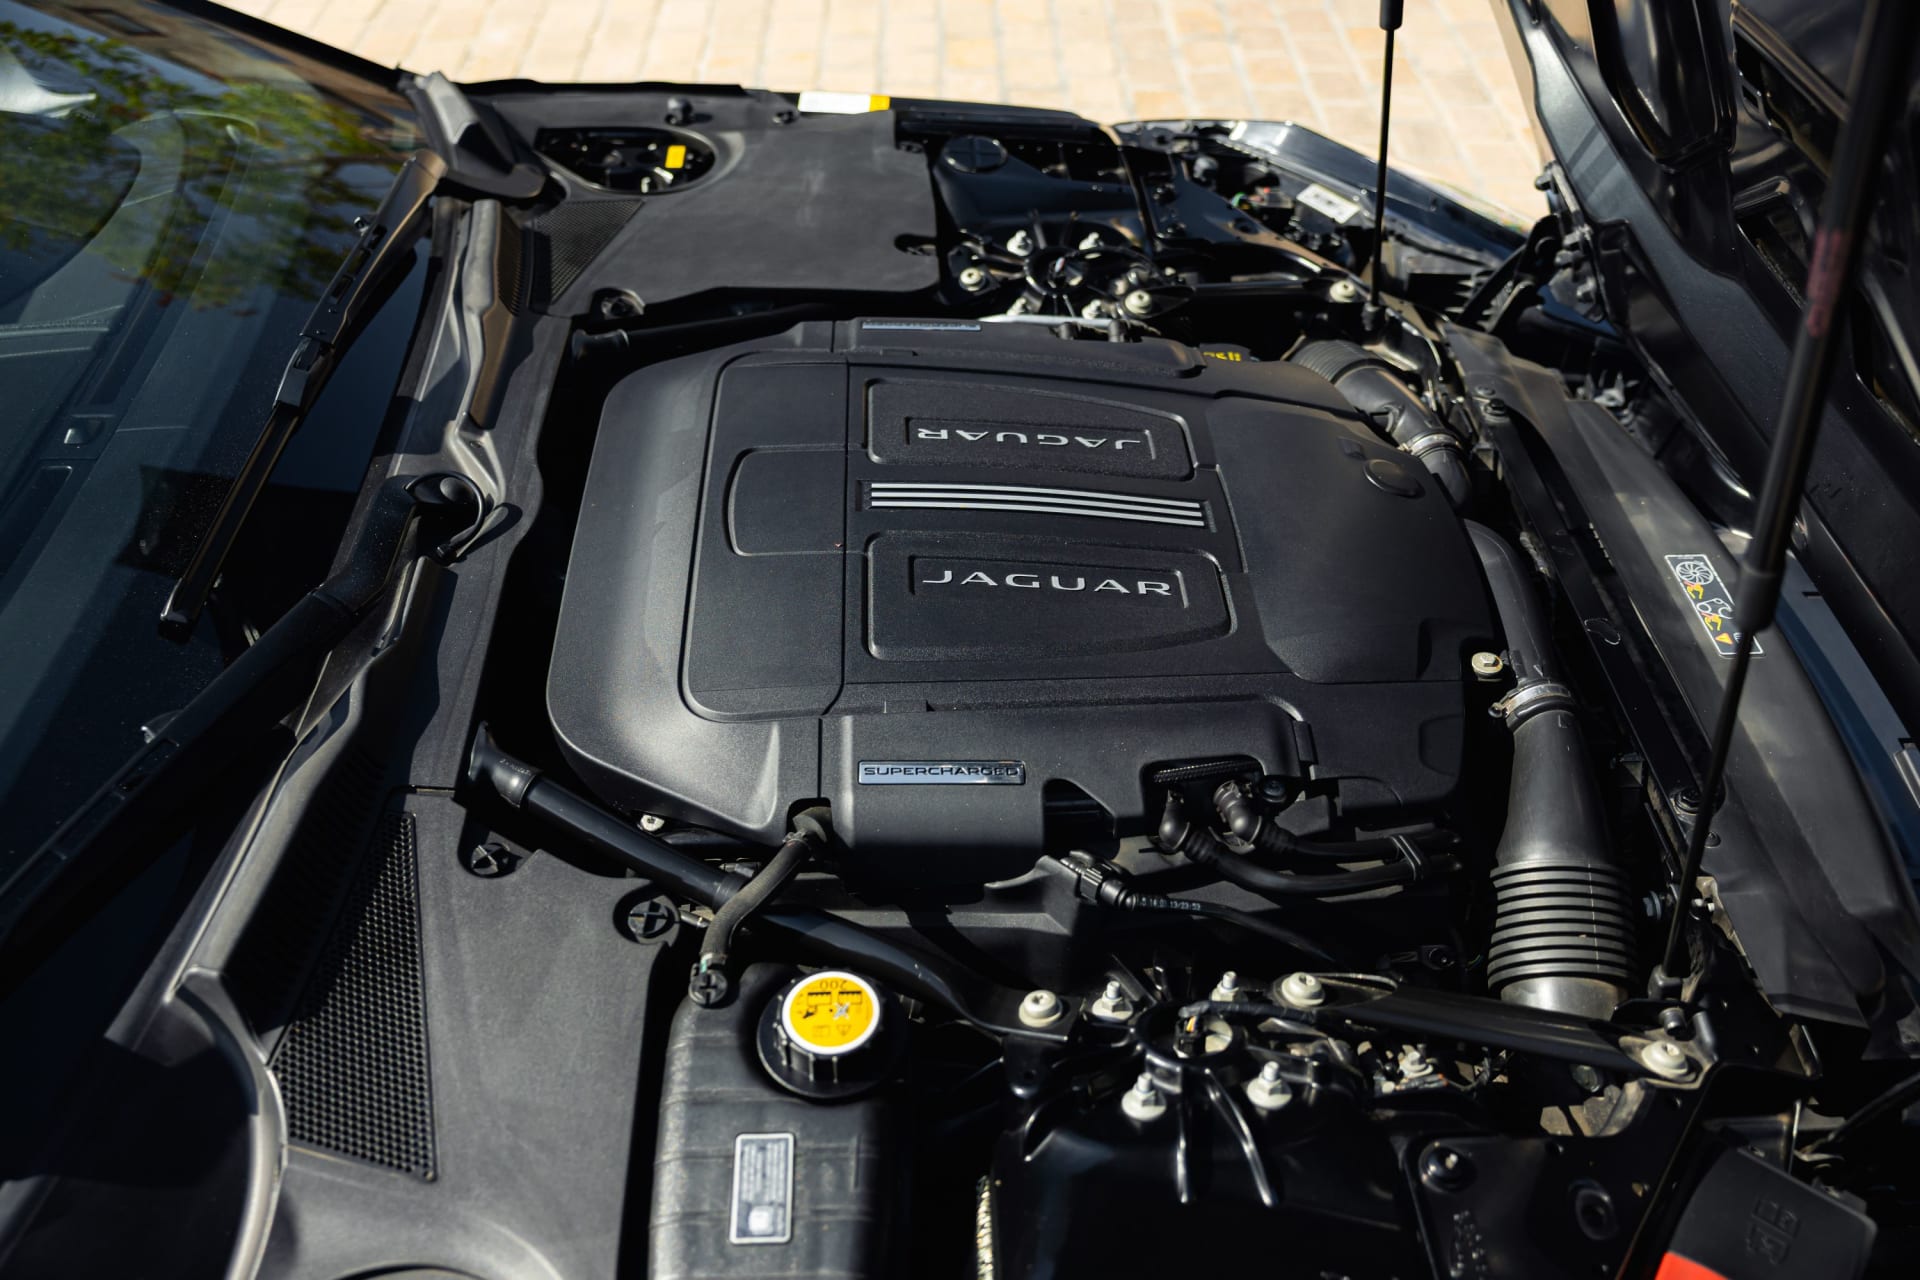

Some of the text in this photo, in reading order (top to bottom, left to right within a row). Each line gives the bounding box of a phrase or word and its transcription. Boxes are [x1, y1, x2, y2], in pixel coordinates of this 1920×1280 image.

[917, 428, 1142, 450] JAGUAR
[922, 570, 1172, 596] JAGUAR
[863, 766, 1019, 776] SUPERCHARGED
